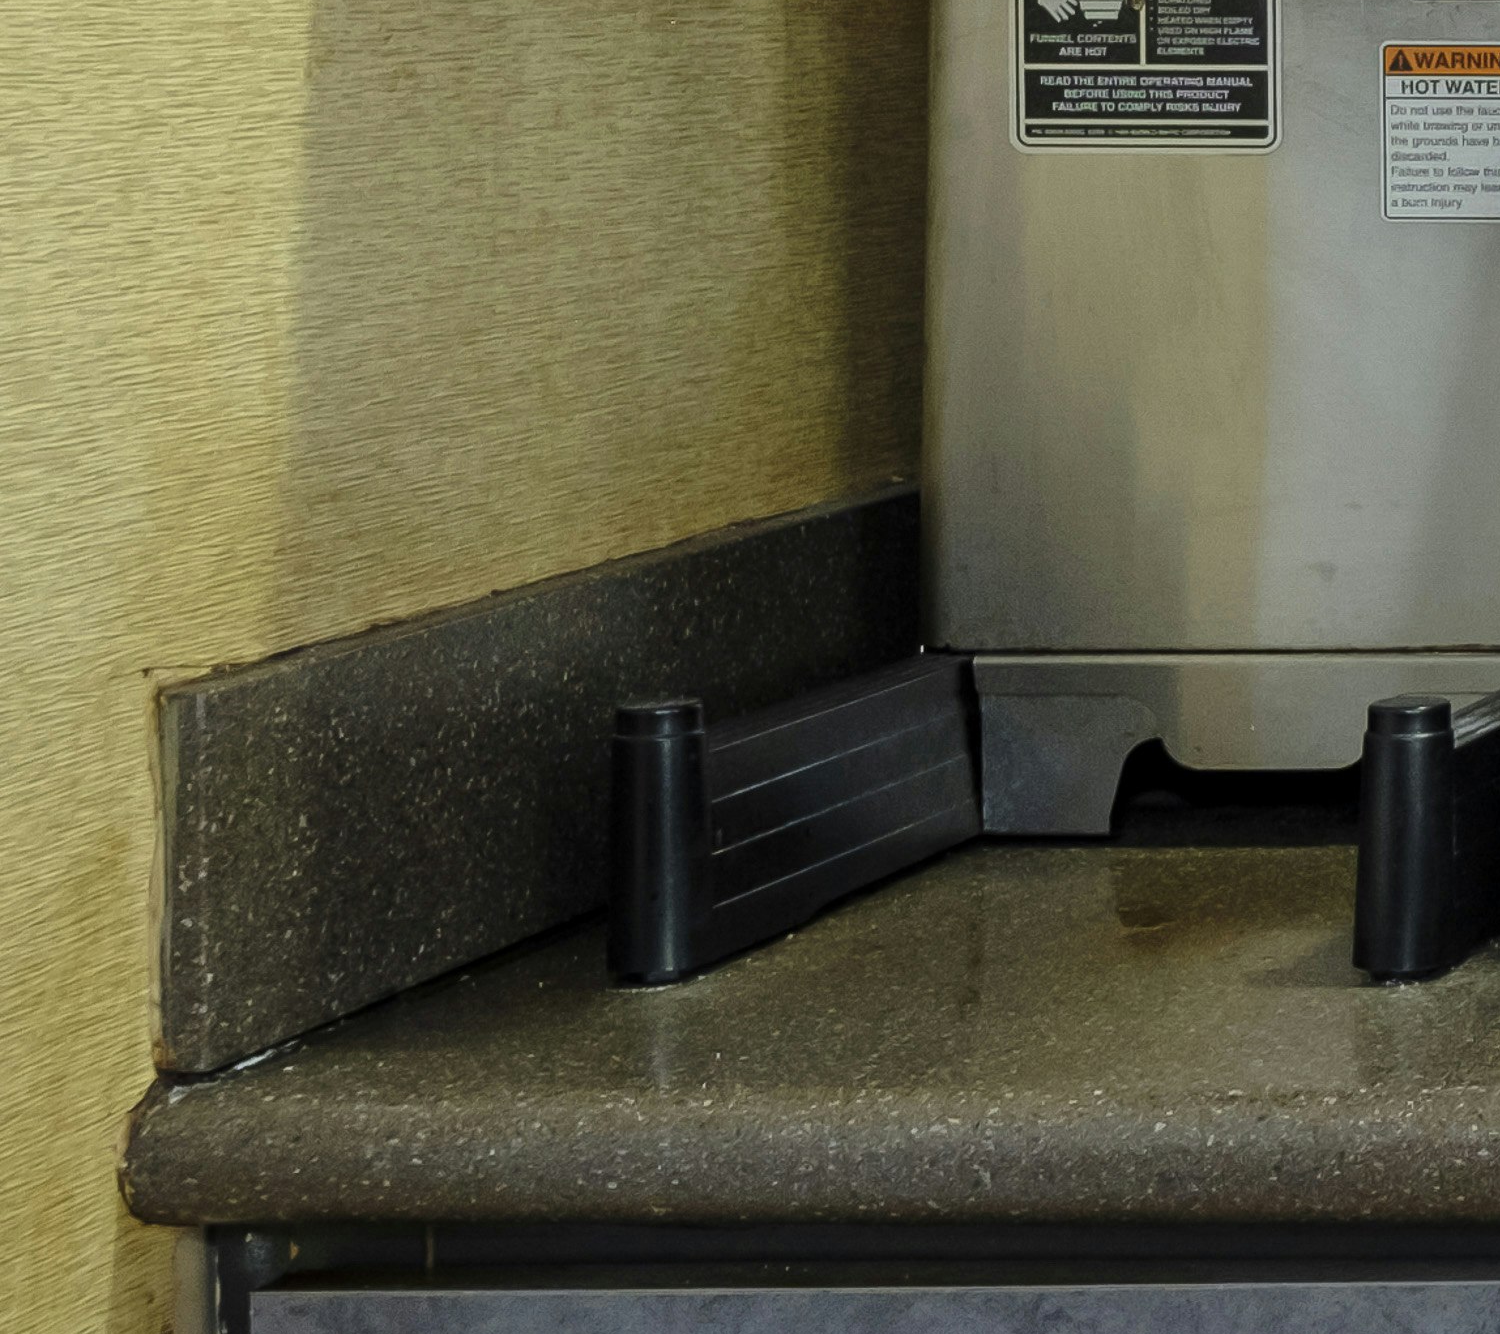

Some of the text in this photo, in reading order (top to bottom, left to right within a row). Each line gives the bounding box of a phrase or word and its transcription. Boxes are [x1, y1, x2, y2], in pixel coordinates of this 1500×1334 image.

[1059, 47, 1082, 56] ARE
[1041, 76, 1071, 86] READ
[1074, 76, 1094, 86] THE
[1097, 76, 1137, 86] ENTIRE
[1207, 77, 1253, 87] MANUAL
[1401, 80, 1440, 94] HOT
[1064, 89, 1230, 99] BEFORE USING THIS PRODUCT
[1052, 102, 1098, 112] FAILURE
[1101, 102, 1115, 112] TO
[1118, 102, 1162, 112] COMPLY
[1391, 105, 1407, 115] Do
[1410, 105, 1429, 115] not
[1432, 107, 1452, 115] use
[1456, 105, 1474, 115] the
[1391, 121, 1419, 131] while
[1472, 123, 1482, 131] or
[1391, 136, 1408, 146] the
[1412, 136, 1458, 148] grounds
[1462, 136, 1489, 147] have
[1433, 167, 1444, 177] to
[1453, 185, 1478, 195] may
[1391, 199, 1398, 207] a
